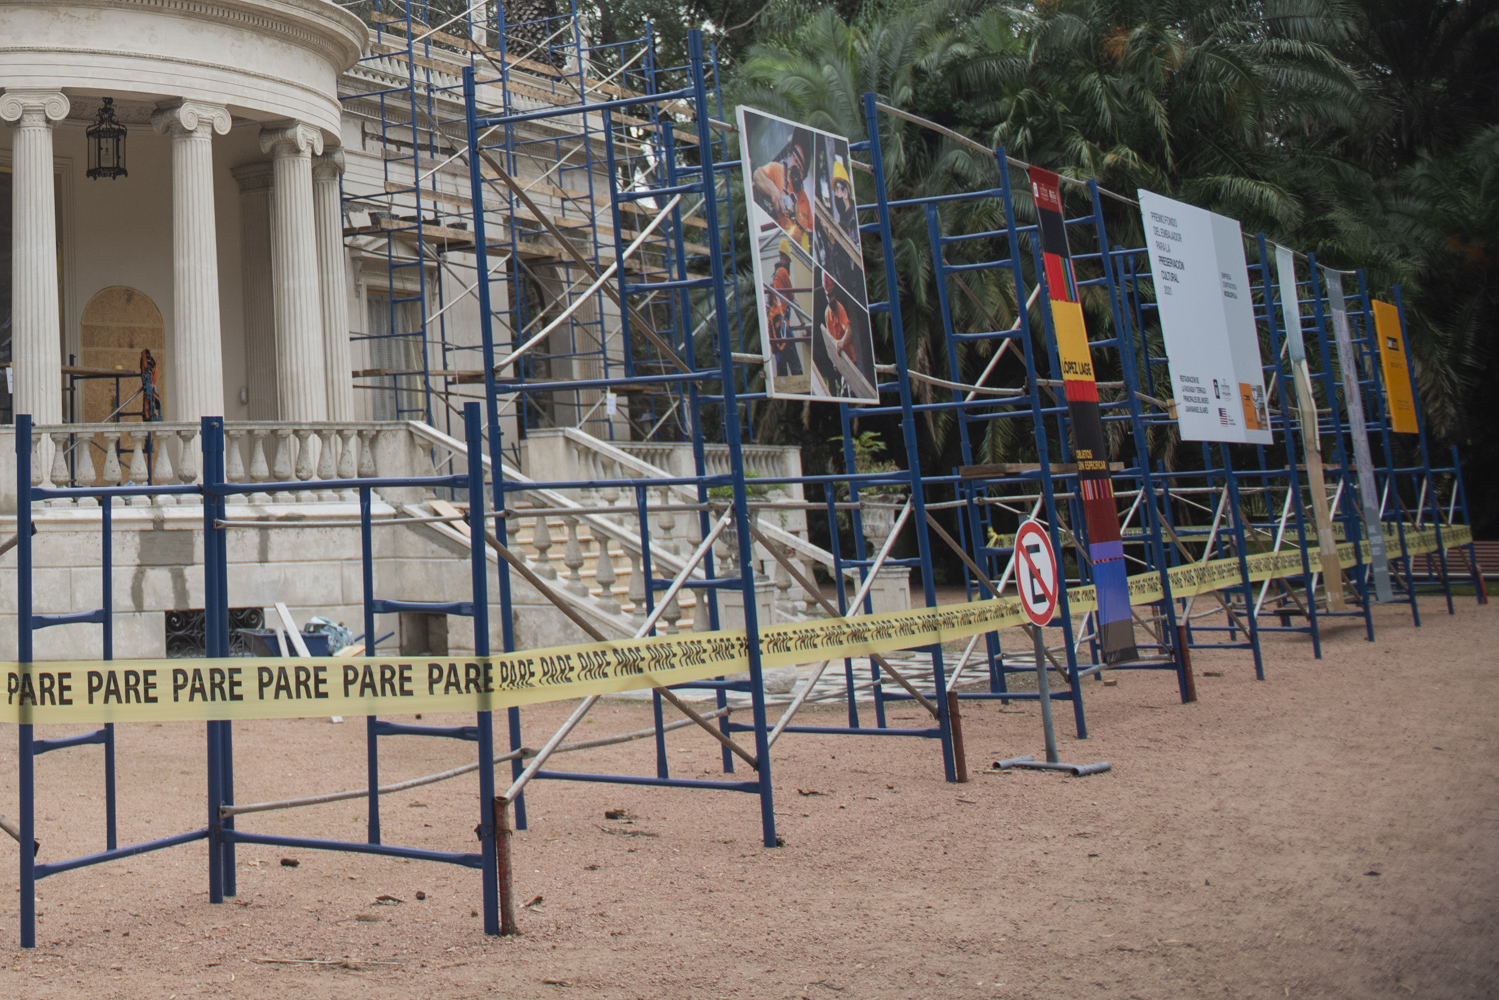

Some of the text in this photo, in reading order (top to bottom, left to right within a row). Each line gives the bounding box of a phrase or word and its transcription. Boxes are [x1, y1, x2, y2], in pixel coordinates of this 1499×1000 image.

[1062, 357, 1092, 376] LÓPEZ LAGE
[1026, 544, 1047, 604] E
[7, 672, 73, 706] PARE
[87, 669, 159, 704] PARE
[172, 667, 244, 702] PARE
[257, 665, 329, 700] PARE
[342, 664, 414, 698] PARE
[428, 662, 495, 695] PARE
[500, 657, 536, 690] PARE
[539, 654, 572, 685] PARE
[577, 650, 609, 681] PARE
[613, 646, 646, 677] PARE
